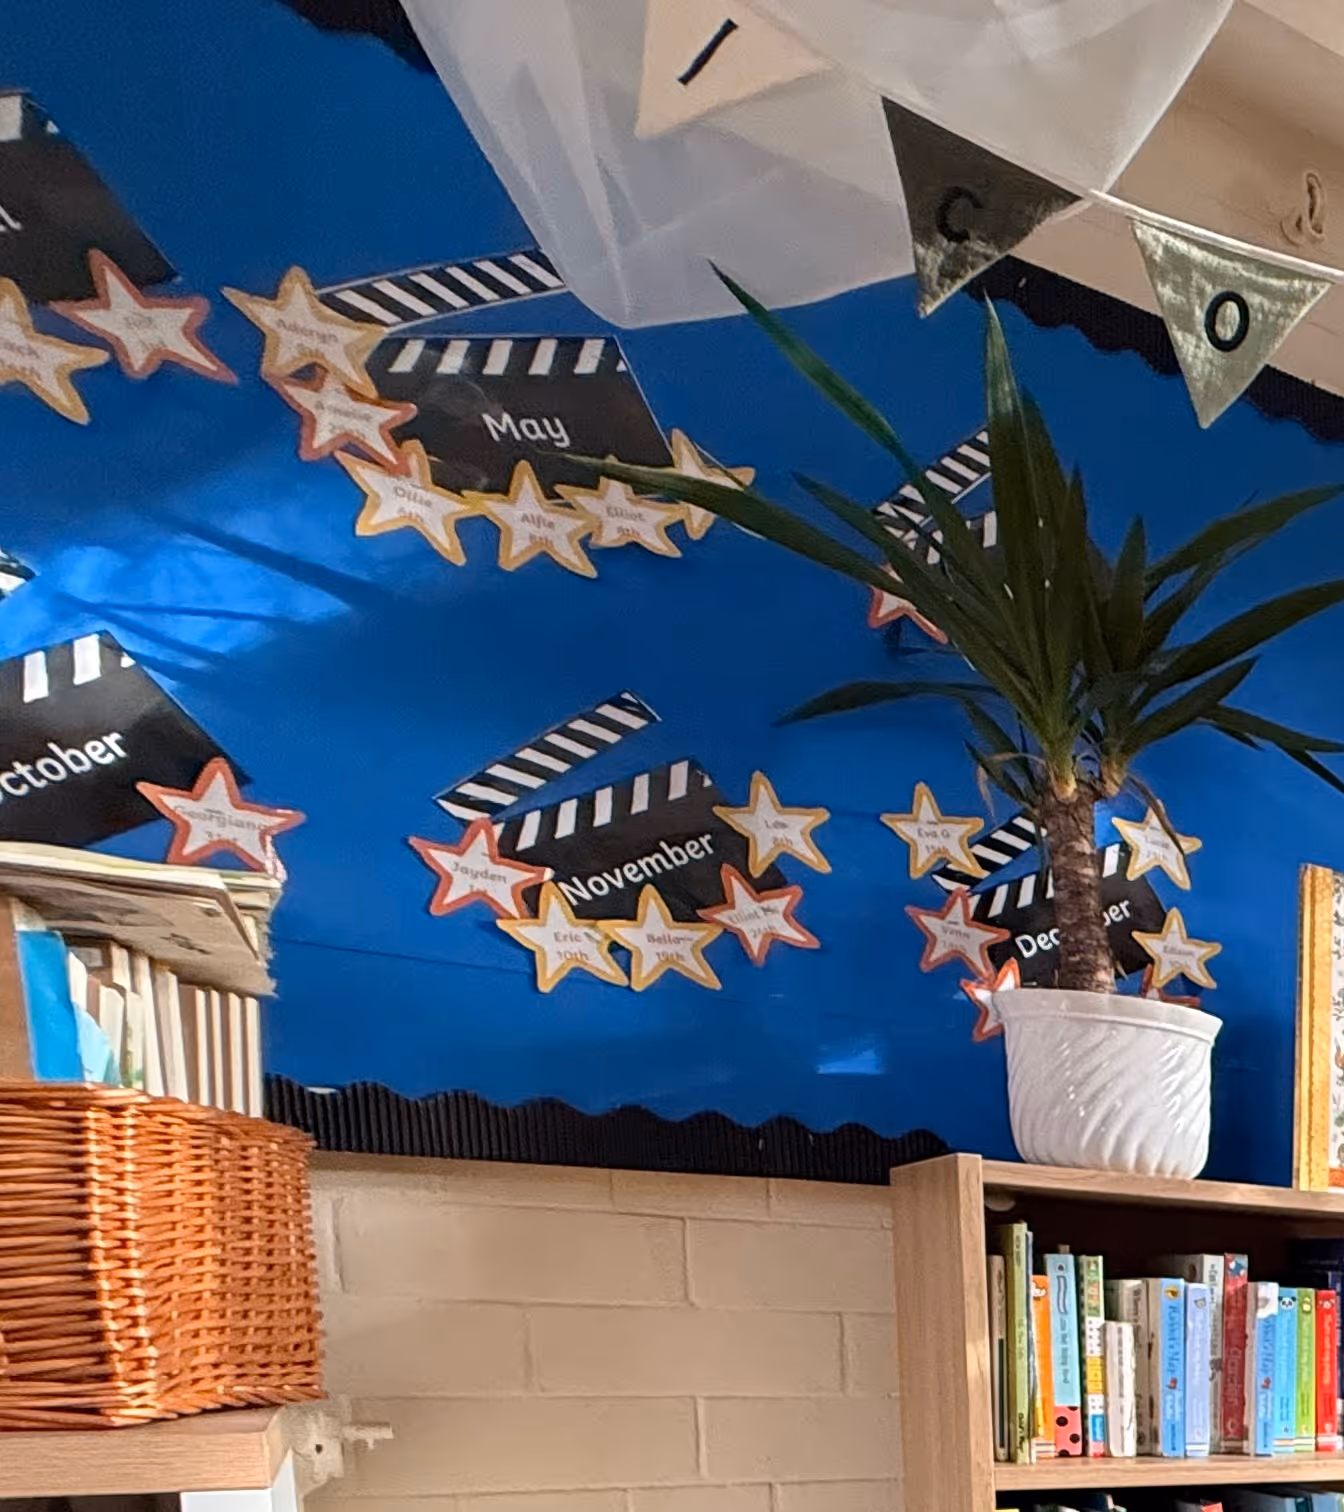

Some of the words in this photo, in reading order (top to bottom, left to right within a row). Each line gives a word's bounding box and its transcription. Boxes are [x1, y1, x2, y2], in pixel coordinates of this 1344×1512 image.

[481, 412, 571, 448] May
[0, 731, 128, 799] ctober
[452, 860, 507, 884] Jayden
[560, 832, 714, 907] November
[553, 931, 582, 943] Eric
